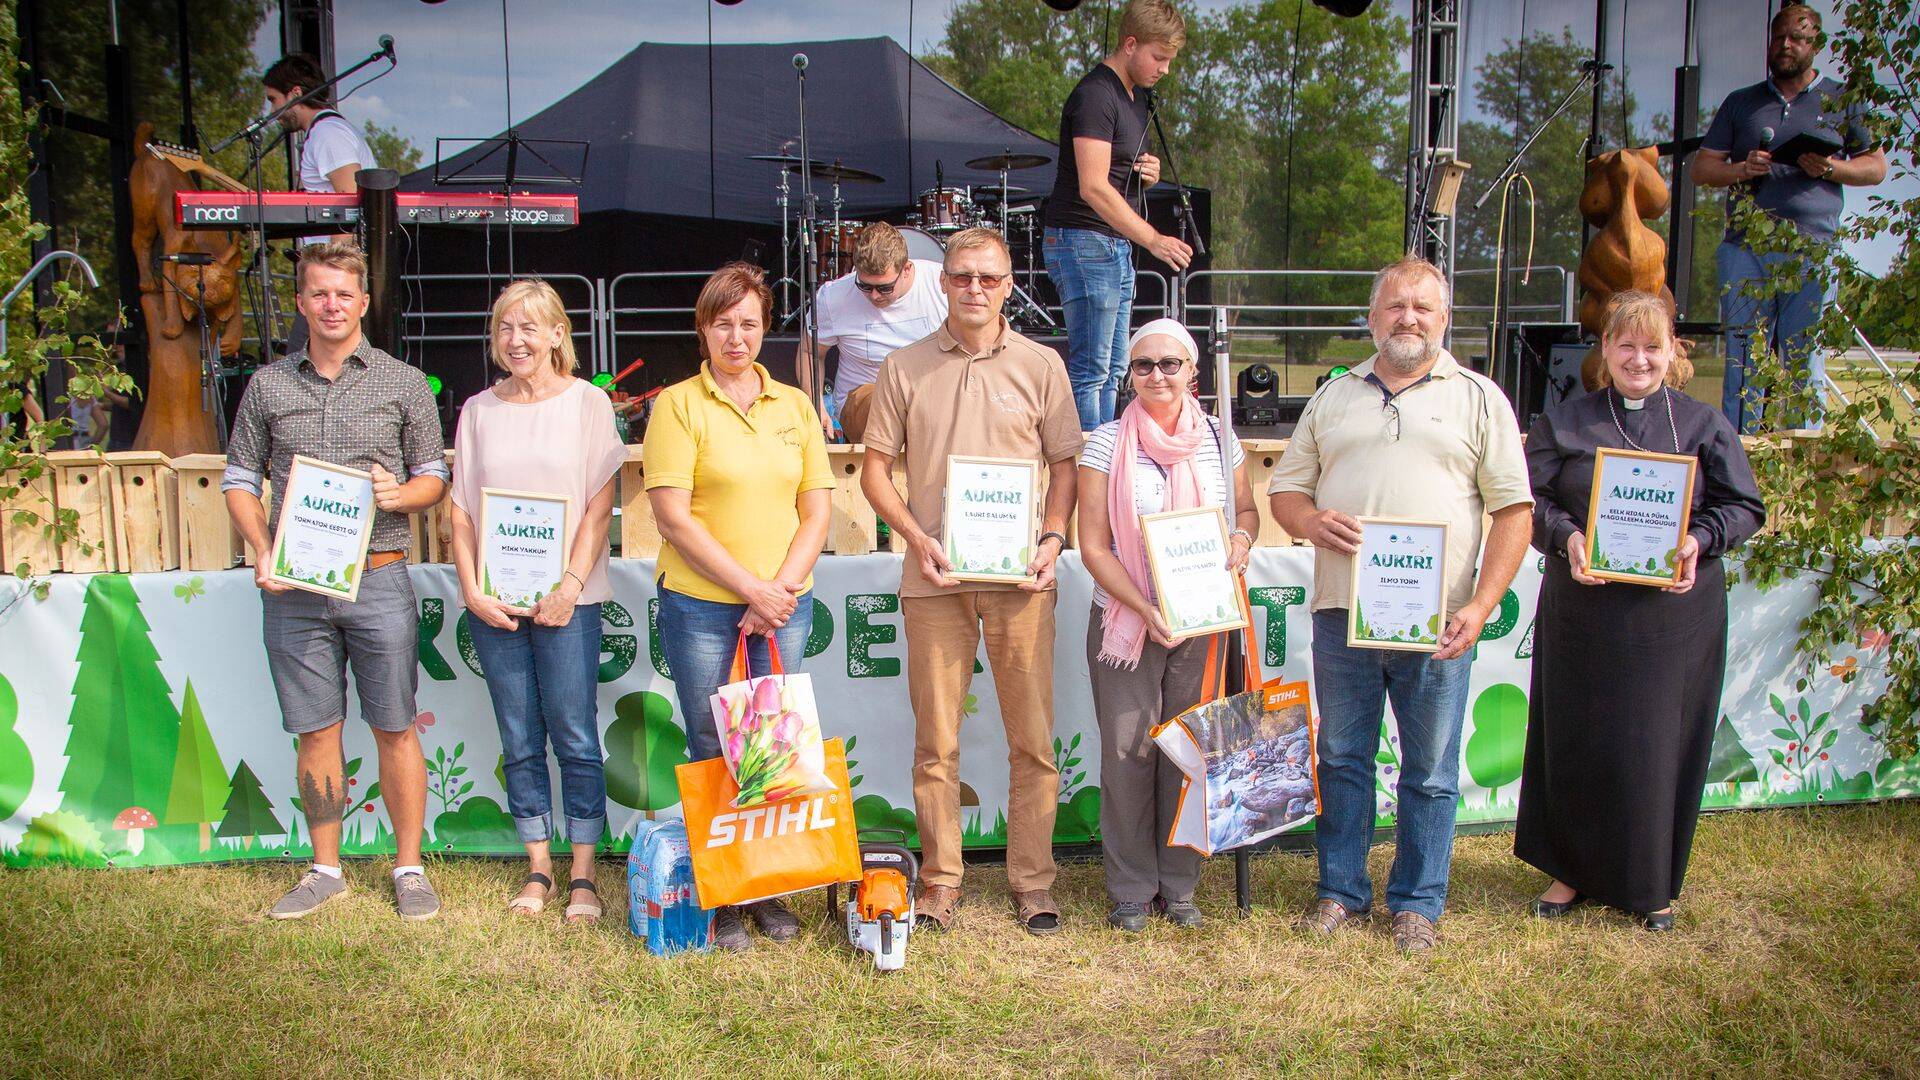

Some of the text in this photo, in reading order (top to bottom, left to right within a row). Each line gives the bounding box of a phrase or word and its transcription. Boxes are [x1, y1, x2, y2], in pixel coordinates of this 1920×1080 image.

[195, 206, 239, 221] nord
[505, 208, 549, 224] stage
[964, 489, 1022, 505] AUKIRI
[1609, 485, 1675, 505] AUKIRI
[302, 494, 360, 519] AUKIRI
[294, 515, 328, 529] TORNATOR
[329, 523, 347, 533] EESTI
[1600, 514, 1644, 524] MAGDALEENA
[495, 523, 555, 540] AUKIRI
[1368, 553, 1433, 570] AUKIRI
[1268, 689, 1300, 705] STIHL
